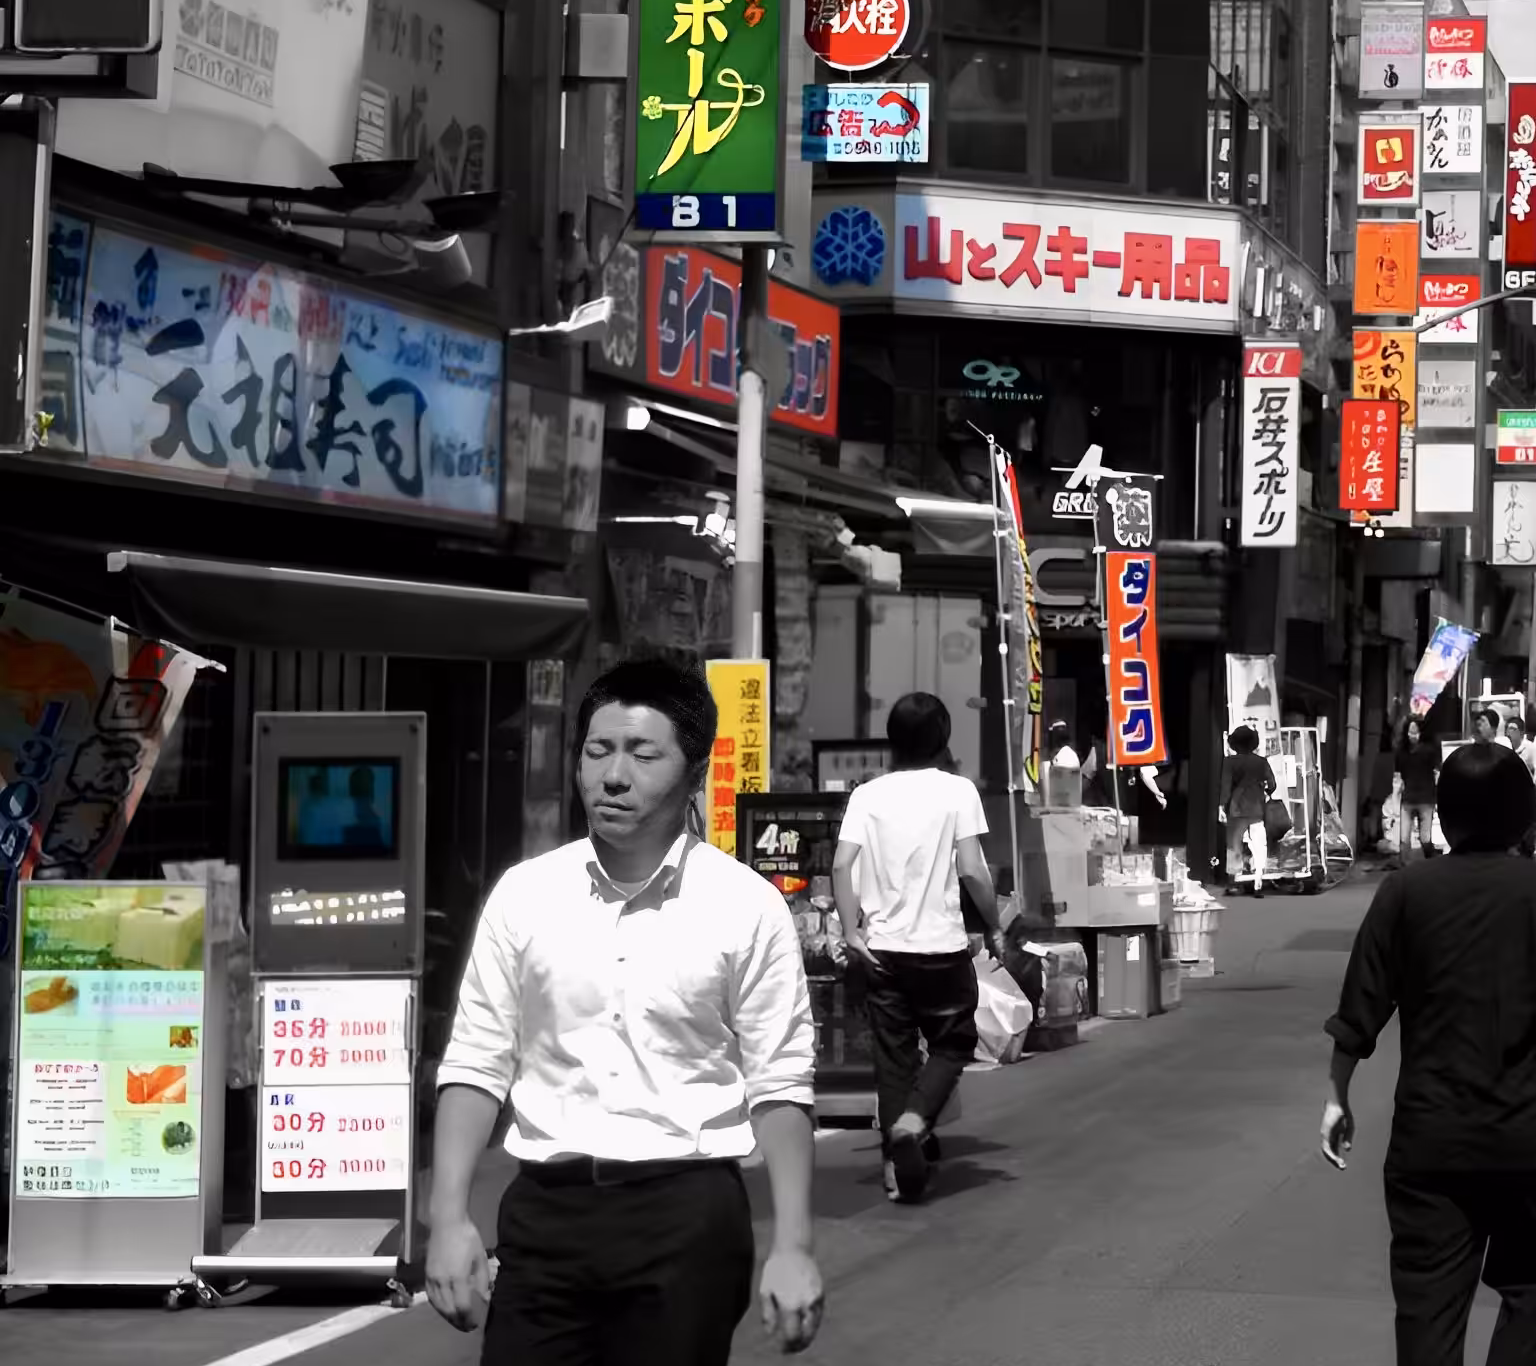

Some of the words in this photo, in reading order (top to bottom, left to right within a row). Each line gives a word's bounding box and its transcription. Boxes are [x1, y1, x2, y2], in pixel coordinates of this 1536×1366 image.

[671, 195, 737, 228] B1
[904, 216, 1230, 304] 山とスキー用品
[1247, 352, 1284, 374] ICI
[1251, 386, 1290, 538] 石井スポーツ
